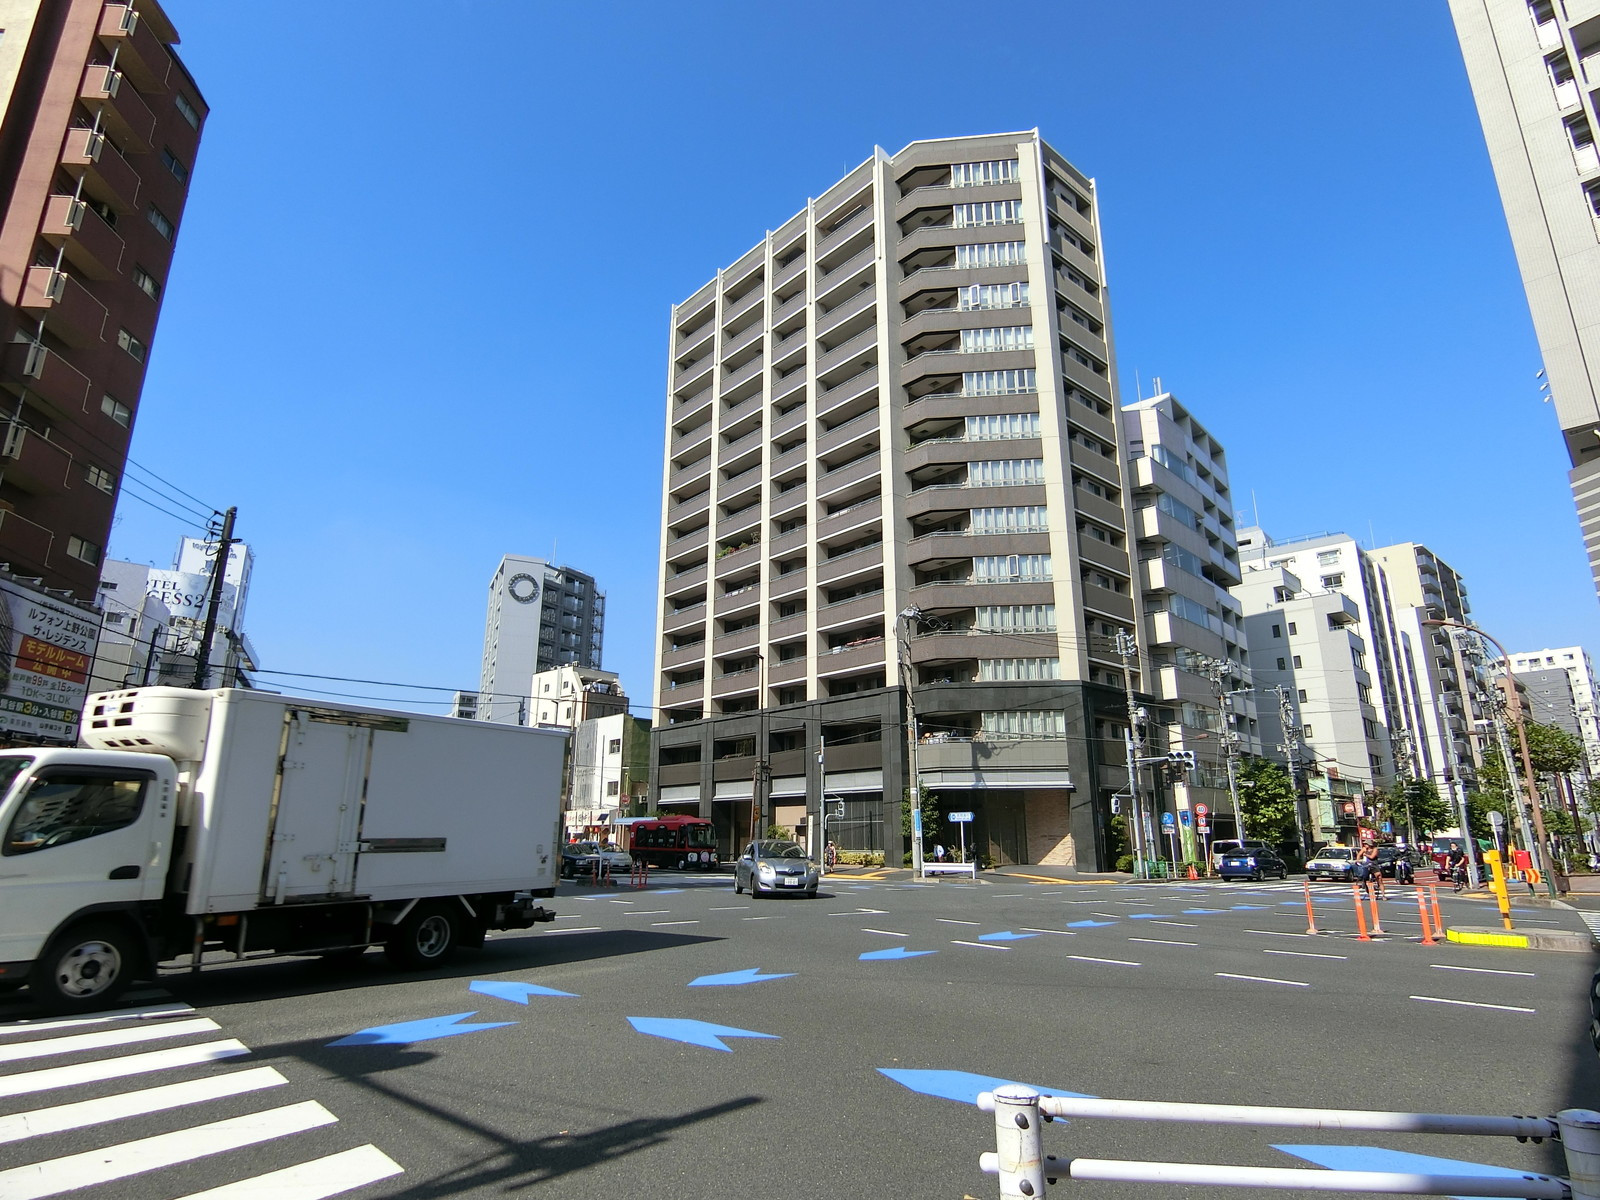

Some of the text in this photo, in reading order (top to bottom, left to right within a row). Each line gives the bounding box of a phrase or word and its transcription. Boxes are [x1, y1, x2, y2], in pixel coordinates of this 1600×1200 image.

[146, 579, 180, 591] TEL
[28, 608, 96, 640] ルフォン上野公園
[33, 624, 87, 652] ザ・レジデンス
[26, 640, 85, 668] モデルルーム
[32, 658, 72, 679] 公開中
